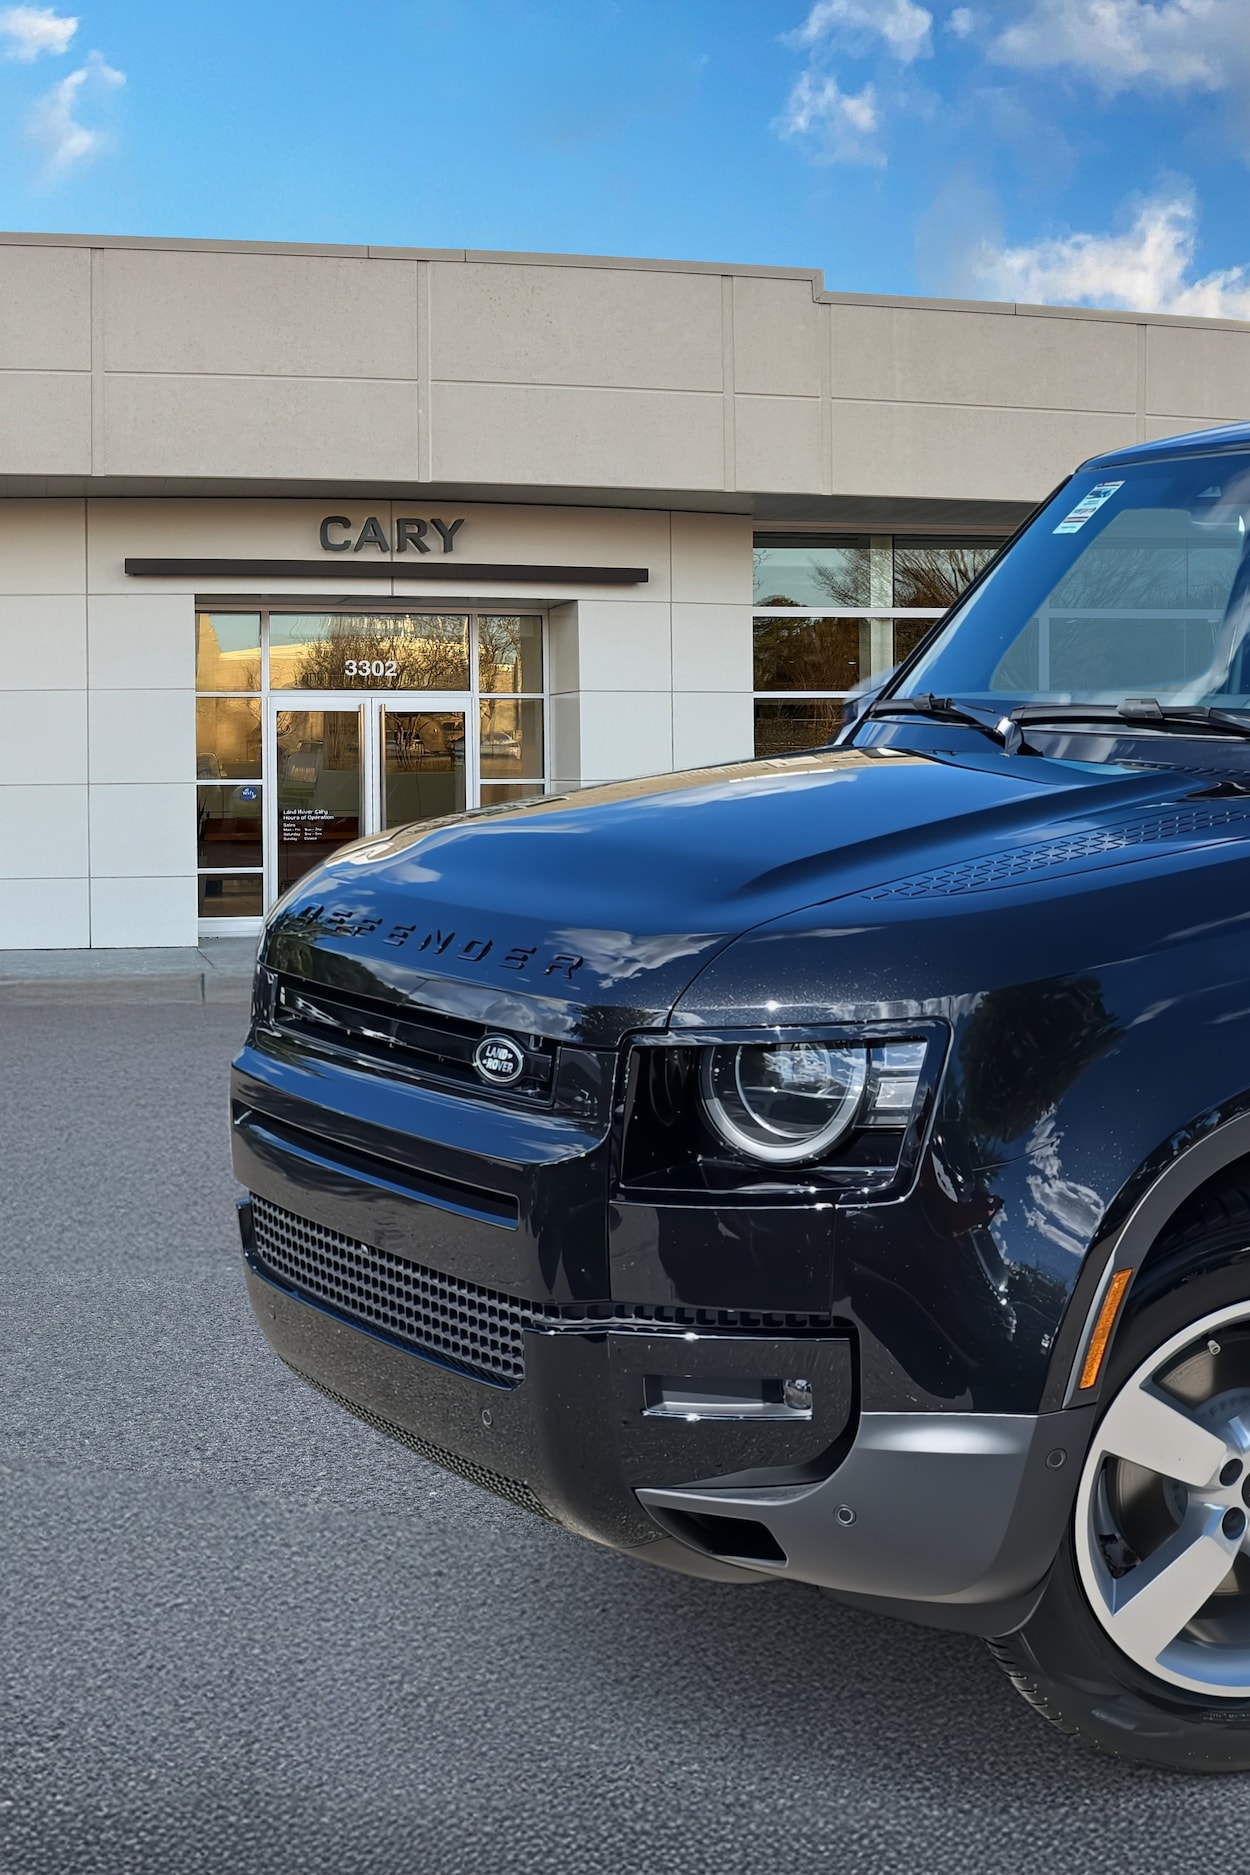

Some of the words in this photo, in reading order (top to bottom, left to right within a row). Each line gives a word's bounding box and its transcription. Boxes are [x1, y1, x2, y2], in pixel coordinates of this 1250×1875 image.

[319, 515, 465, 553] CARY
[344, 659, 398, 677] 3302
[302, 902, 584, 979] DEFENDER
[485, 1045, 508, 1060] LAND
[485, 1057, 514, 1073] ROVER
